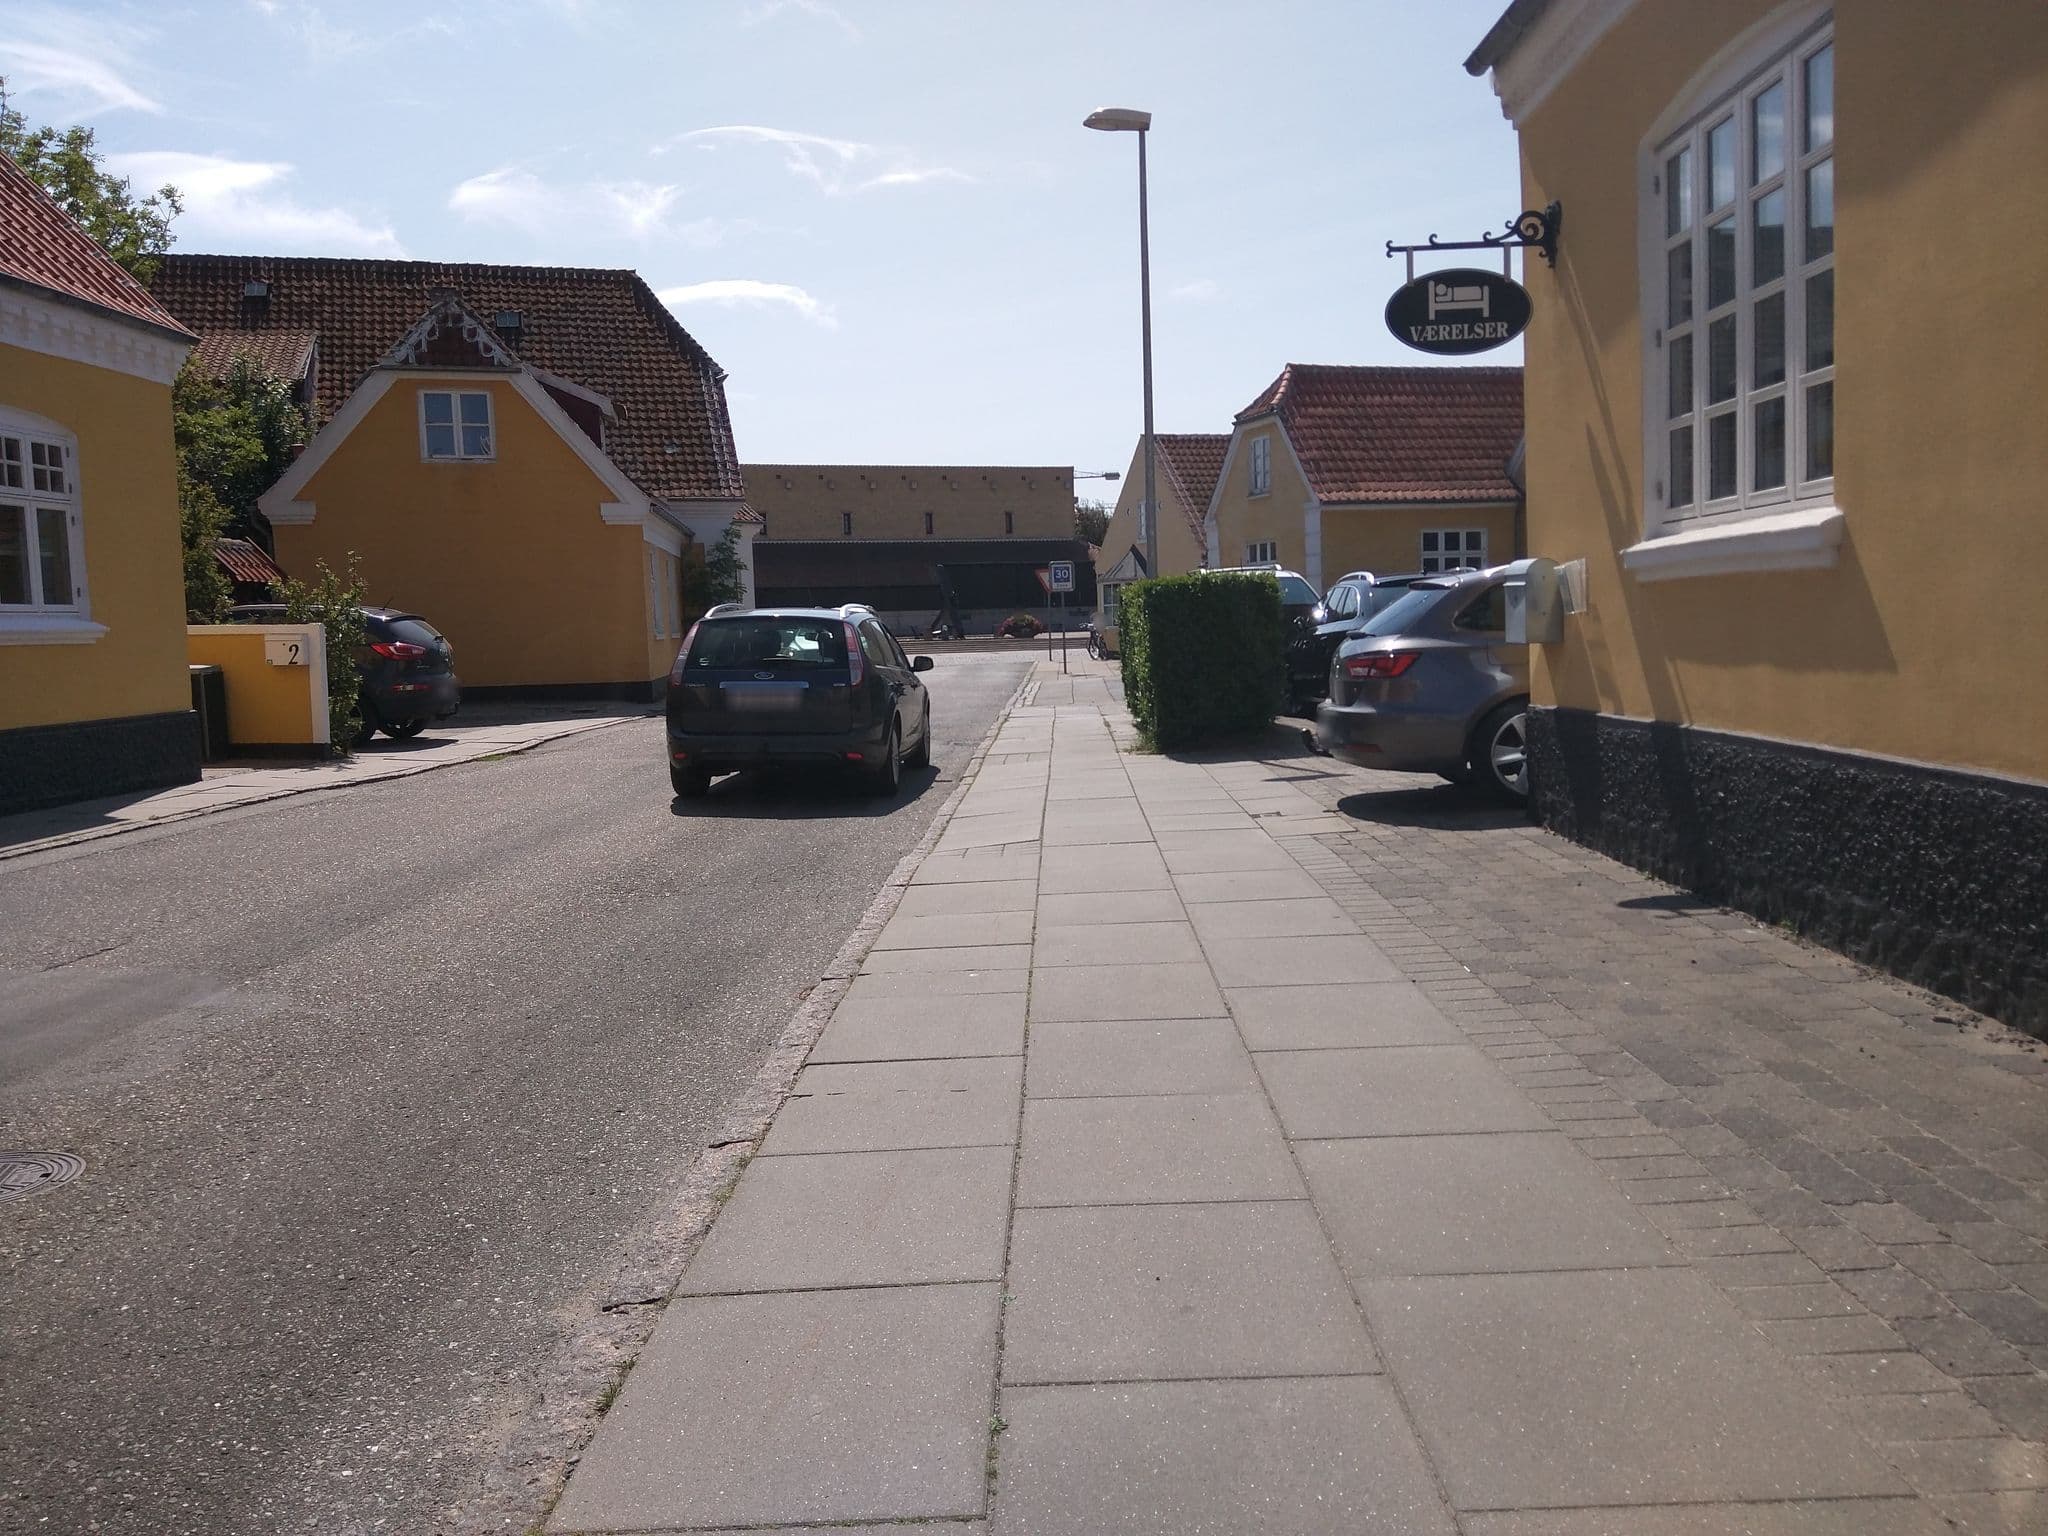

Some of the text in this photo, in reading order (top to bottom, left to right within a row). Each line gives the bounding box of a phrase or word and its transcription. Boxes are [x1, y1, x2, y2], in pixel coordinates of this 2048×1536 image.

[1409, 321, 1509, 342] VÆRELSER
[1055, 569, 1069, 579] 30
[288, 644, 299, 665] 2
